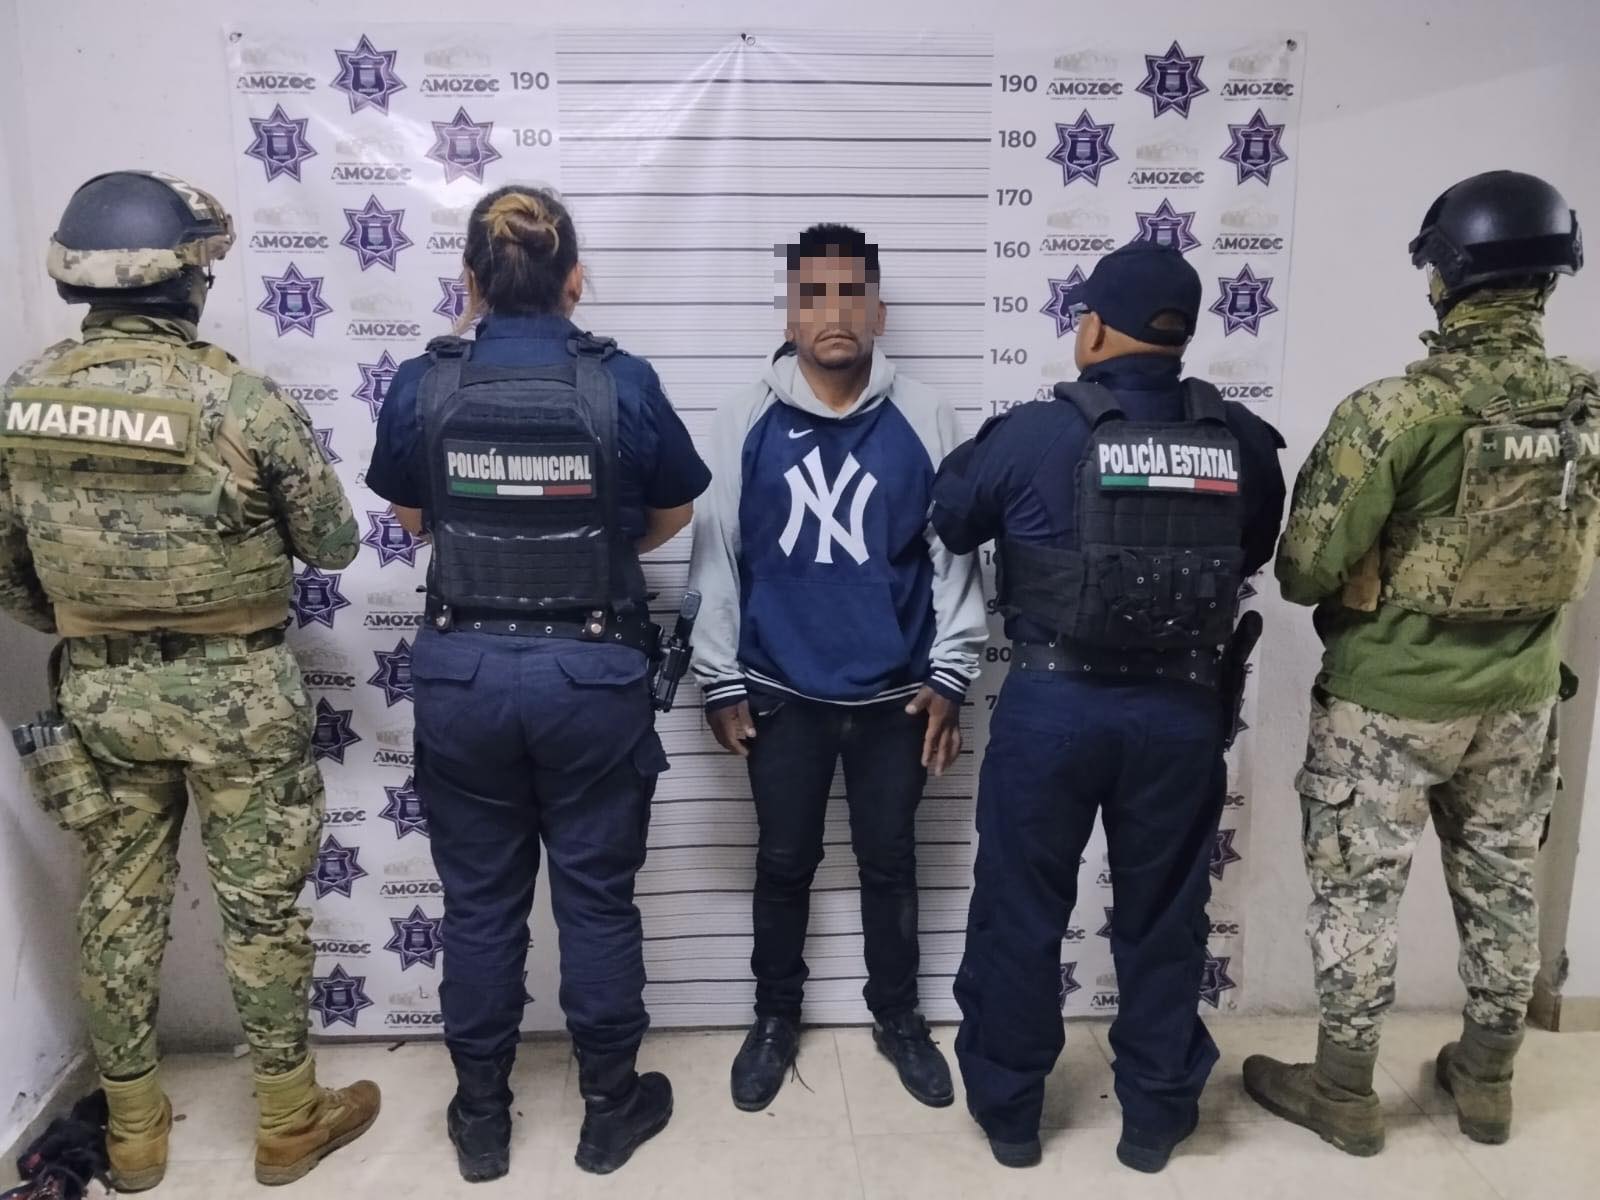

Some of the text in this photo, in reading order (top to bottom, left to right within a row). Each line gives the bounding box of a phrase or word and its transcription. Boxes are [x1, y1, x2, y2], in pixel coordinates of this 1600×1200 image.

[236, 75, 317, 90] AMOZOC
[420, 78, 500, 92] AMOZOC
[510, 72, 549, 90] 190
[1000, 75, 1037, 93] 190
[1046, 82, 1123, 95] AMOZOC
[1220, 82, 1294, 96] AMOZOC
[513, 129, 552, 147] 180
[999, 130, 1036, 148] 180
[331, 167, 412, 181] AMOZOC
[1128, 171, 1205, 184] AMOZOC
[996, 189, 1033, 206] 170
[250, 235, 328, 249] AMOZOC
[427, 236, 468, 250] AMO
[1040, 238, 1115, 251] AMOZOC
[1212, 237, 1283, 250] AMOZOC
[995, 241, 1031, 258] 160
[993, 297, 1028, 313] 150
[346, 323, 421, 337] AMOZOC
[990, 348, 1027, 364] 140
[286, 388, 339, 401] OZOC
[6, 401, 175, 446] MARINA
[447, 447, 592, 481] POLICÍA MUNICIPAL
[1098, 437, 1239, 480] POLICÍA ESTATAL
[778, 445, 878, 566] NY
[985, 647, 1012, 662] 80
[380, 882, 444, 895] AMOZO
[312, 942, 371, 954] MOZOC
[384, 1013, 444, 1025] AMOZO
